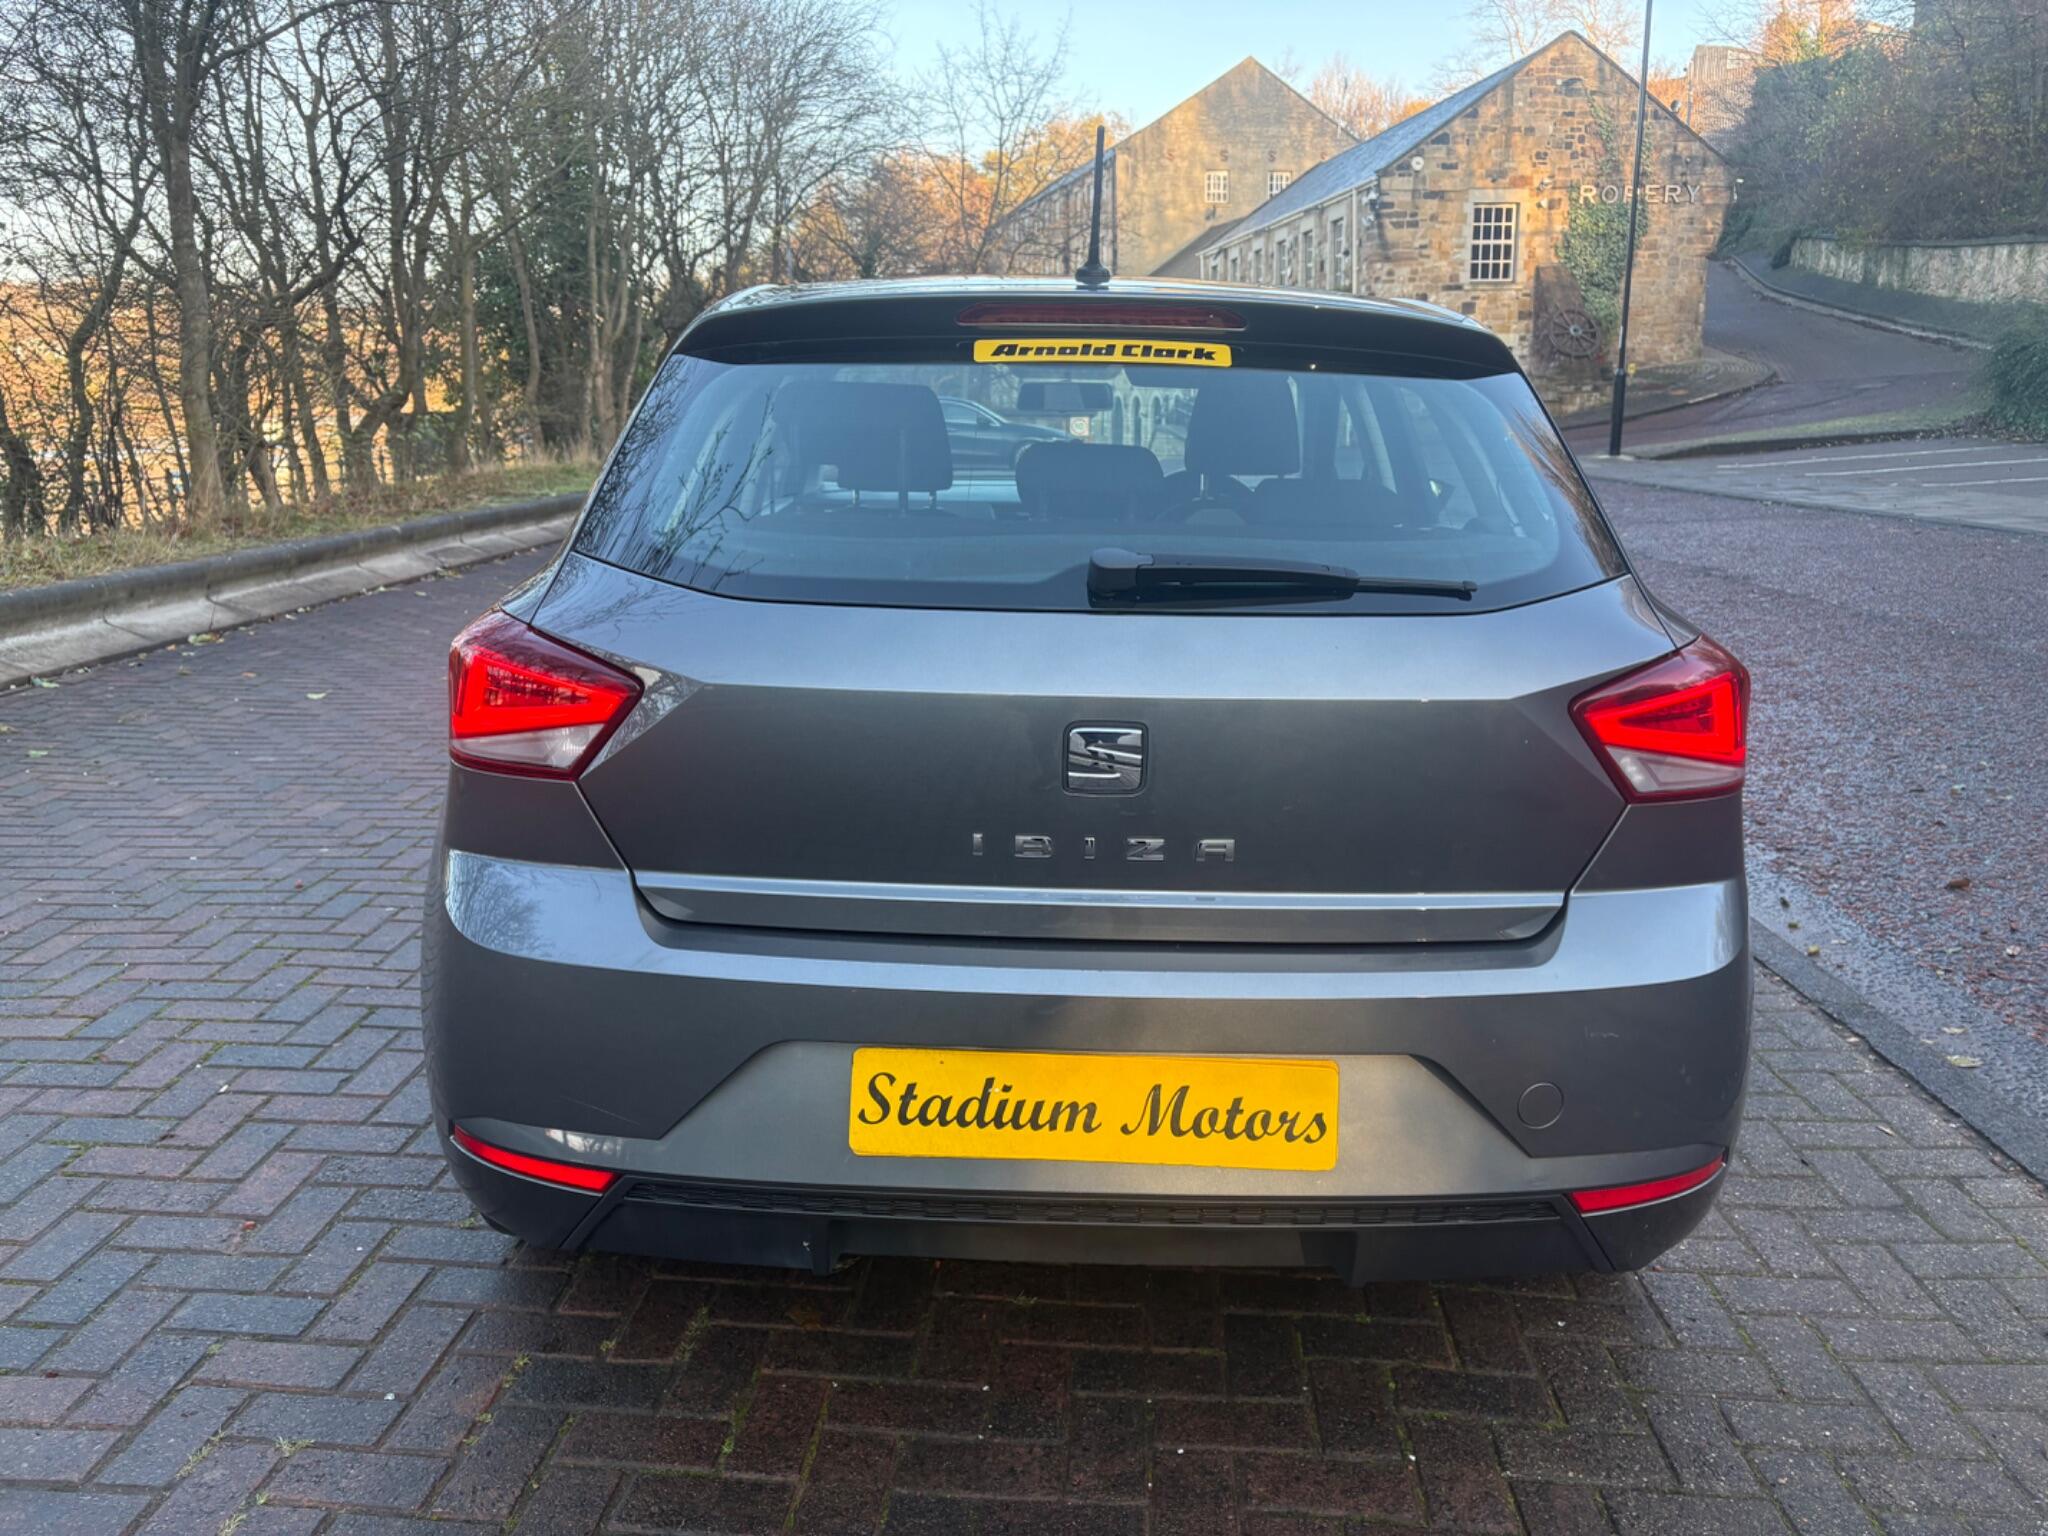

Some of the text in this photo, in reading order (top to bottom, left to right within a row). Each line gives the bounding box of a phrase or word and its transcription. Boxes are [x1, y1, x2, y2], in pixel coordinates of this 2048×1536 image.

[1579, 184, 1700, 204] ROPERY
[990, 343, 1216, 360] Arnold Clark
[972, 833, 1235, 861] IBIZA
[858, 1071, 1327, 1144] Stadium Motors
